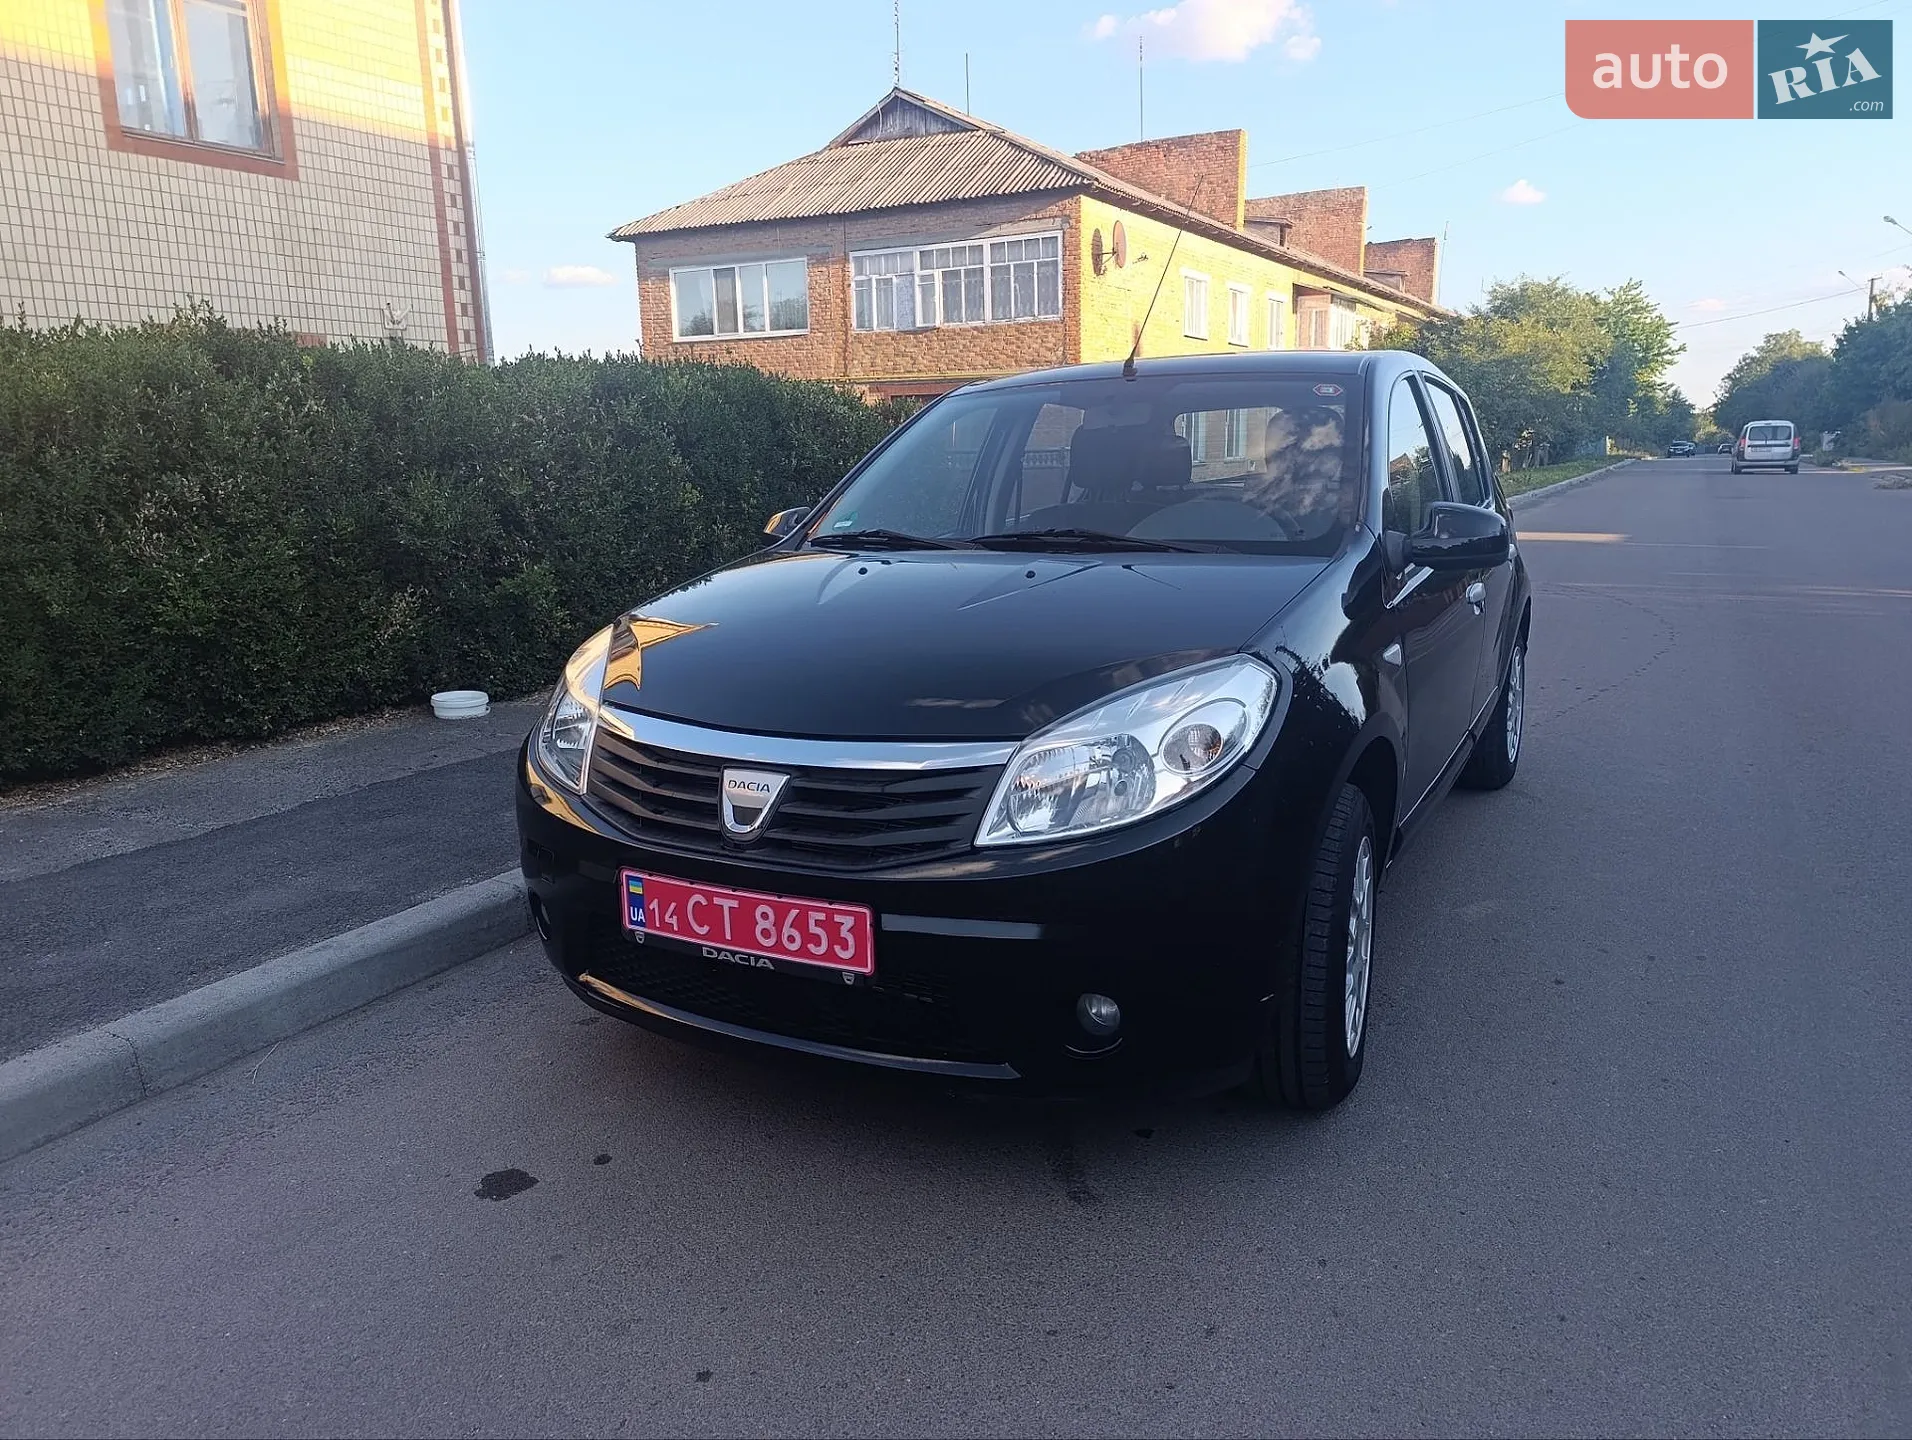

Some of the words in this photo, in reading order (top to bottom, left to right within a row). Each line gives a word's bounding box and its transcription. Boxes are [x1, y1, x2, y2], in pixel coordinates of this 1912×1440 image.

[727, 779, 771, 793] DACIA
[630, 906, 646, 923] UA
[754, 904, 856, 960] 8653
[702, 946, 775, 970] DACIA
